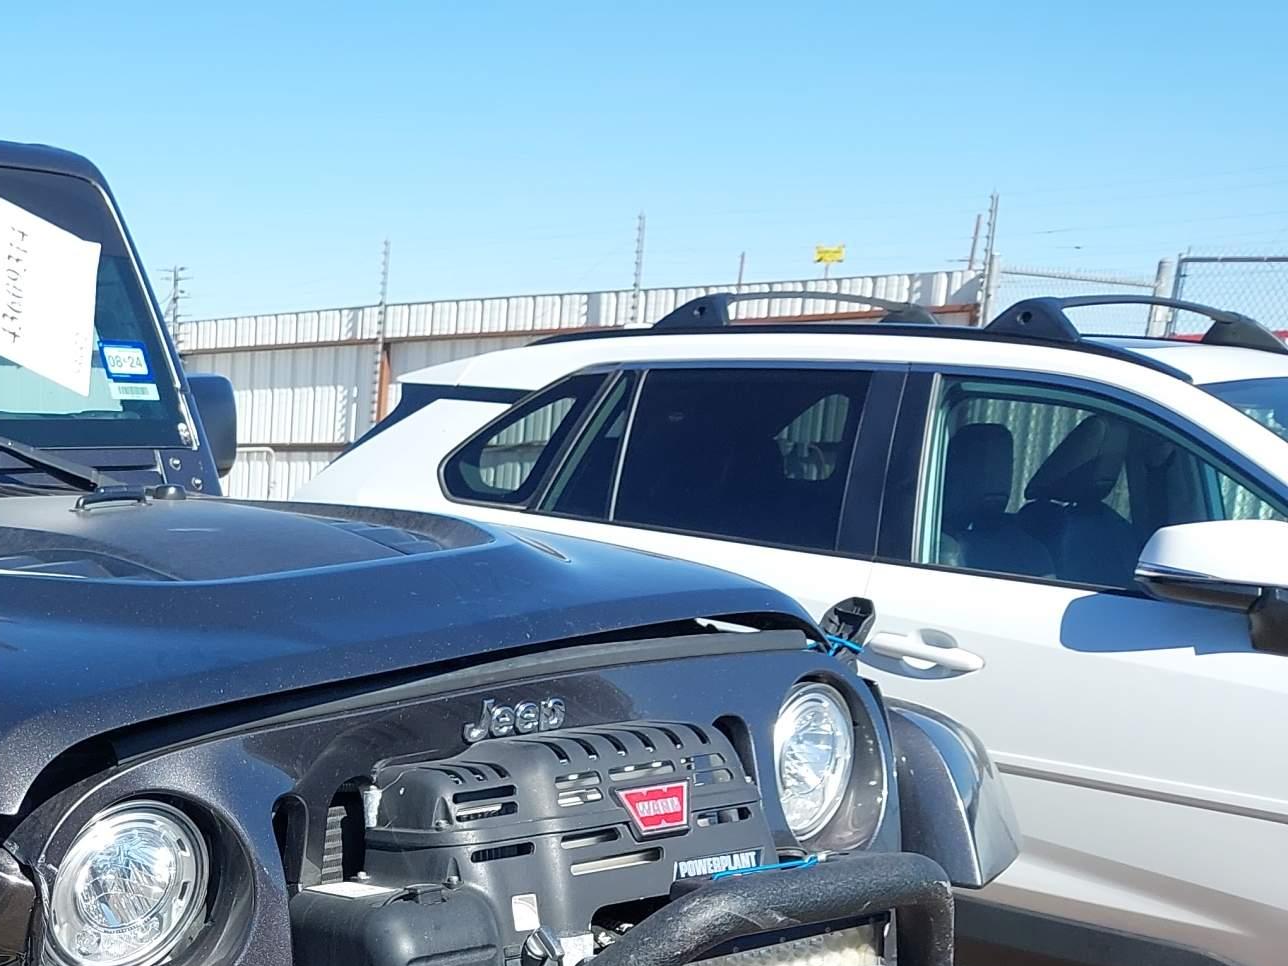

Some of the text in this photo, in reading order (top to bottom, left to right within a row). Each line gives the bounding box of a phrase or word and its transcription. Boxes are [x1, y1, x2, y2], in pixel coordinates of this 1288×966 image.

[462, 698, 566, 744] Jeep
[635, 797, 681, 818] WARN
[678, 851, 757, 878] POWERPLANT
